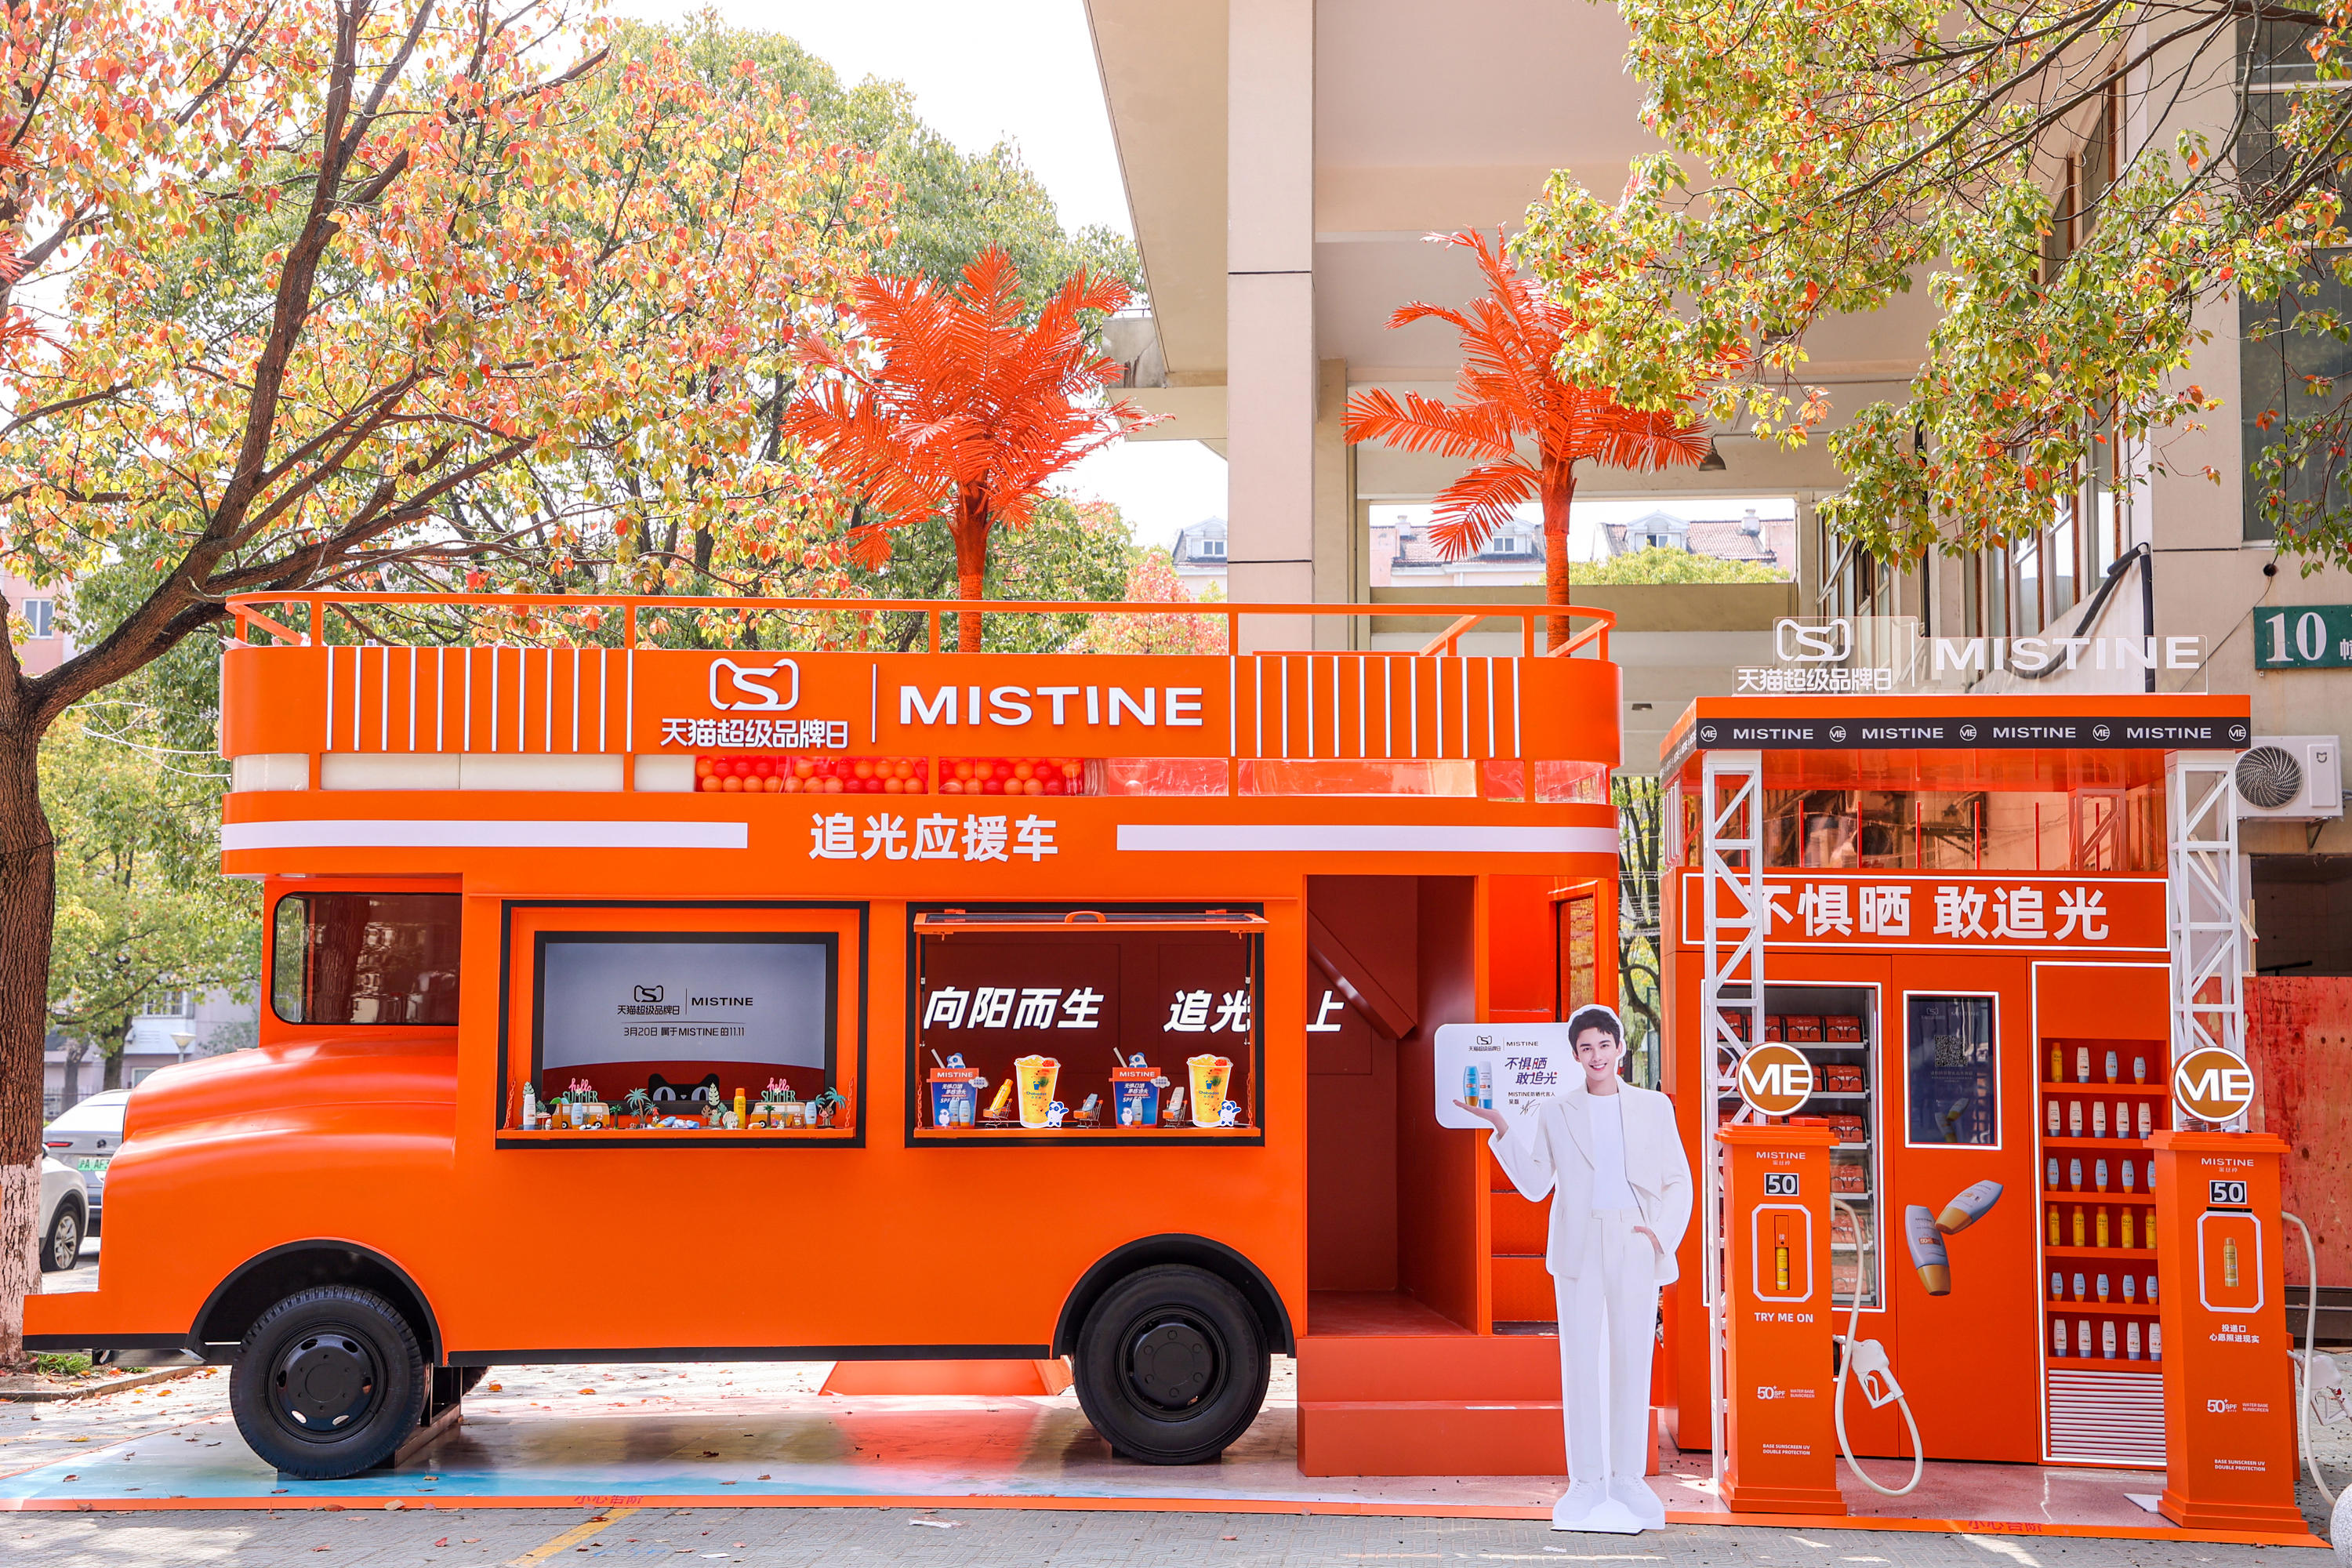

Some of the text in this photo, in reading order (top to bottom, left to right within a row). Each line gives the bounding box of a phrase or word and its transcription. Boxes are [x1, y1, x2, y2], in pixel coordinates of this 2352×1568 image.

[2265, 612, 2327, 662] 10
[1936, 637, 2200, 671] MISTINE
[1737, 667, 1892, 692] 天猫超级品牌日
[899, 685, 1204, 727] MISTINE
[660, 718, 848, 749] 天猫超级品牌日
[1733, 728, 1814, 740] MISTINE
[1861, 728, 1944, 739] MISTINE
[1992, 727, 2076, 739] MISTINE
[2126, 727, 2212, 739] MISTINE
[808, 812, 1058, 862] 追光应援车
[1742, 884, 2109, 942] 不惧晒 敢追光
[617, 1004, 680, 1015] 天猫超级品牌日
[691, 997, 753, 1006] MISTINE
[923, 985, 1104, 1030] 向阳而生
[624, 1027, 657, 1036] 3月20日
[1504, 1057, 1548, 1070] 不惧晒
[1515, 1071, 1558, 1085] 敢追光
[760, 1091, 797, 1102] SUMMER
[2201, 1158, 2255, 1167] MISTINE
[1768, 1175, 1795, 1194] 50
[2213, 1182, 2244, 1203] 50
[1754, 1312, 1813, 1323] TRY ME ON
